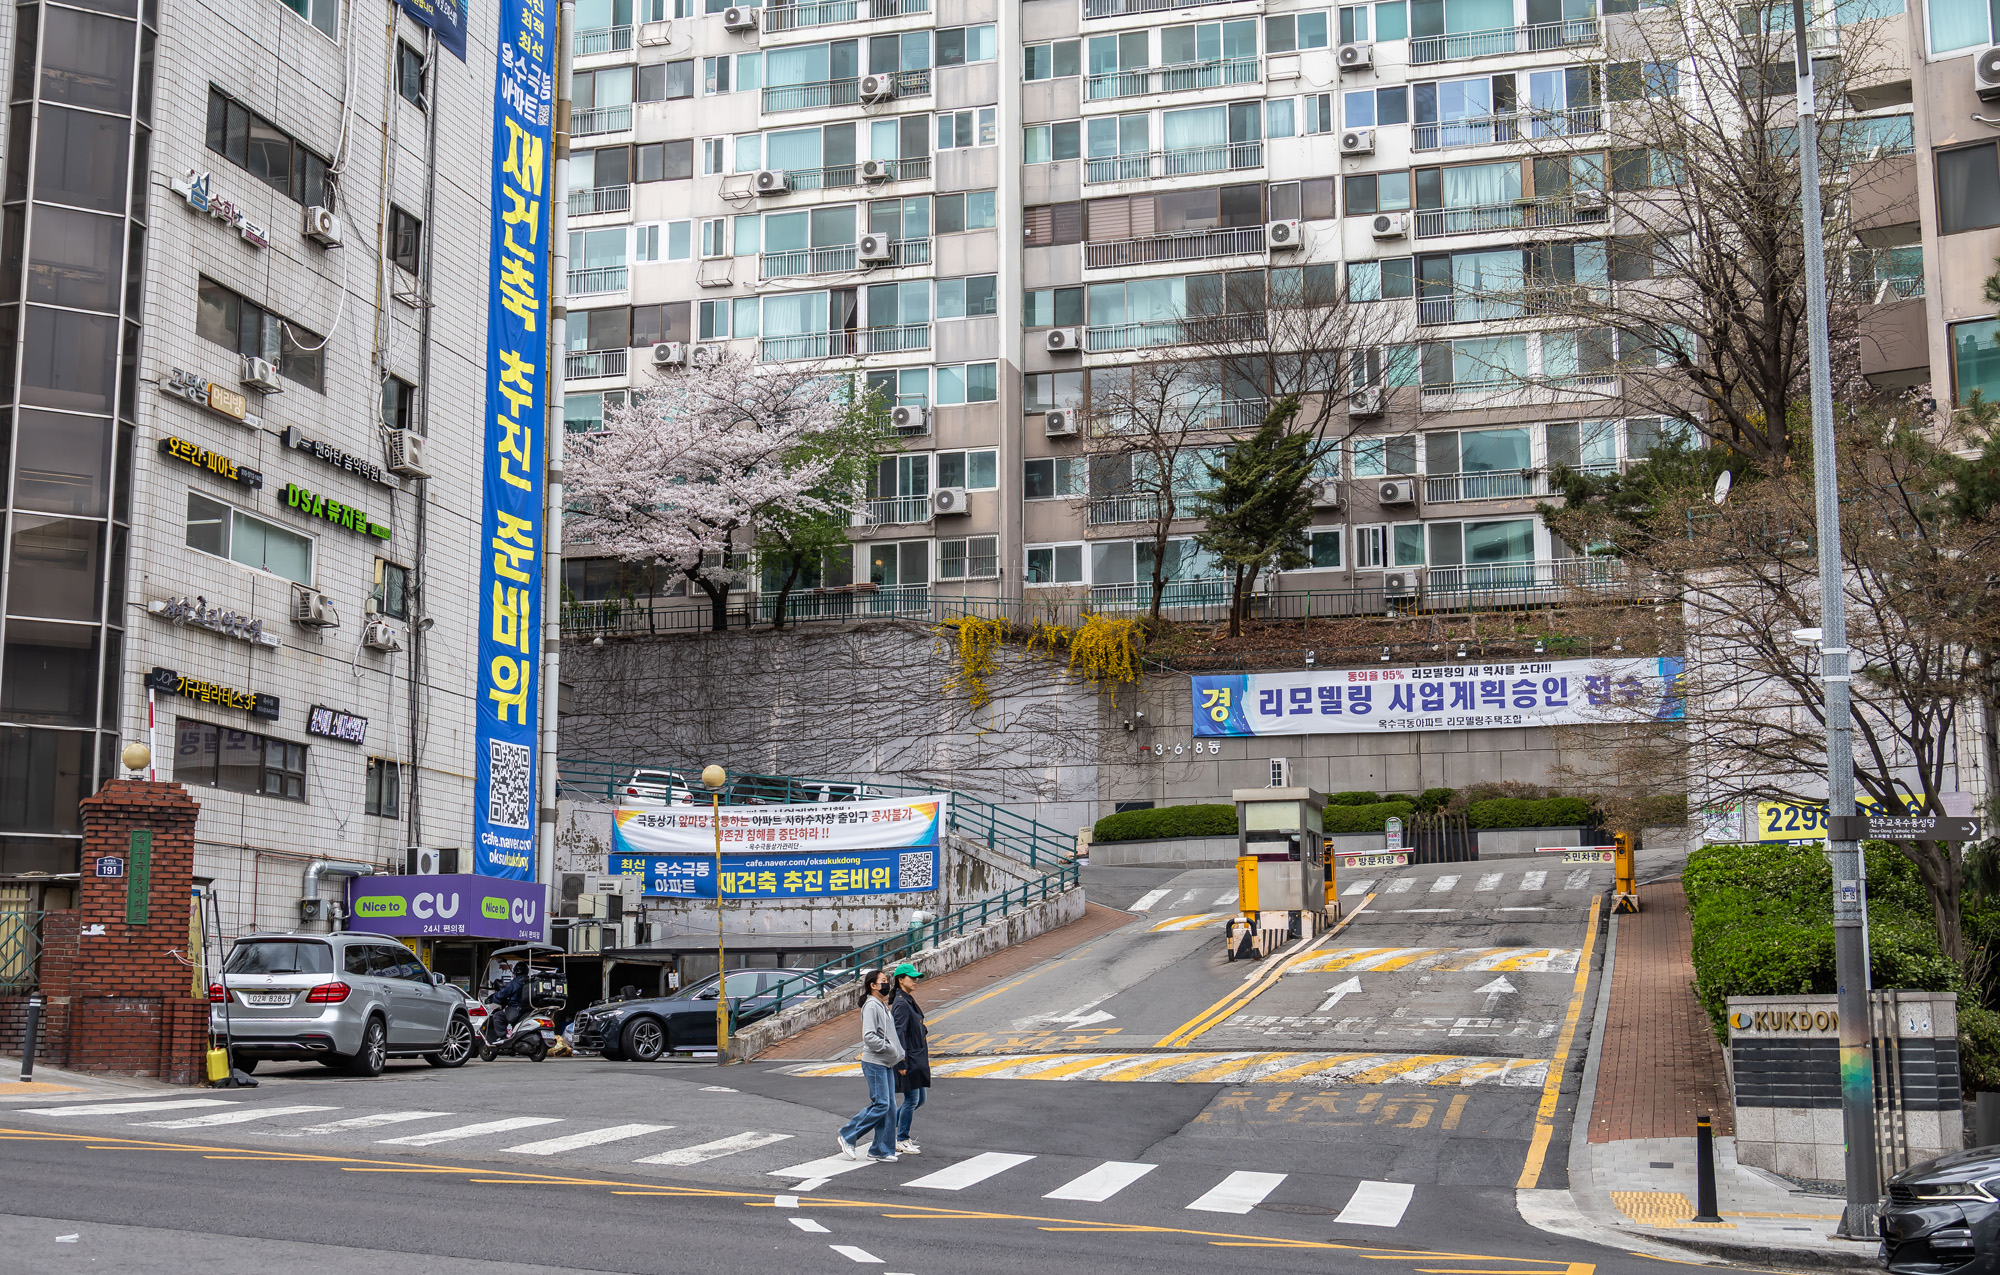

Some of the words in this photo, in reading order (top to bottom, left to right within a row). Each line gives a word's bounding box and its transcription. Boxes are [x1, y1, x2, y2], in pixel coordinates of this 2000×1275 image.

[518, 30, 544, 63] 최선
[502, 42, 551, 101] 옥수극동
[501, 72, 538, 124] 아파트
[499, 114, 543, 332] 재건축
[213, 387, 243, 415] 머리방
[497, 348, 535, 492] 추진
[315, 440, 342, 467] 맨하탄
[344, 453, 379, 483] 음악학원
[288, 483, 323, 518] DSA
[327, 499, 367, 534] 뮤지컬
[489, 508, 535, 726] 준비위
[1347, 670, 1379, 682] 동의율
[1382, 669, 1405, 681] 95%
[1411, 667, 1464, 680] 리모델링의
[1468, 666, 1479, 677] 새
[1483, 664, 1515, 676] 역사를
[1519, 663, 1552, 675] 쓰다!!!
[1201, 687, 1231, 722] 경
[1259, 685, 1372, 717] 리모델링
[1388, 676, 1569, 713] 사업계획승인
[1378, 716, 1443, 729] 옥수극동아파트
[1447, 713, 1522, 727] 리모델링주택조합
[637, 814, 676, 828] 극동상가
[678, 814, 708, 828] 앞마당
[752, 814, 782, 826] 아파트
[838, 810, 868, 824] 출입구
[871, 807, 913, 823] 공사불가
[1869, 818, 1936, 828] 천주교옥수동성당
[746, 827, 776, 842] 침해를
[778, 826, 819, 841] 중단하라
[821, 827, 830, 839] !!
[749, 842, 800, 851] 옥수극동상가관리단
[1563, 851, 1600, 862] 주민차량
[102, 866, 117, 875] 191
[621, 858, 645, 871] 최신
[654, 861, 710, 877] 옥수극동
[745, 856, 861, 868] cafe.naver.com/oksukukdong
[1358, 855, 1395, 867] 방문차량
[133, 835, 146, 921] 옥수극동아파트
[654, 878, 696, 893] 아파트
[720, 869, 778, 894] 재건축
[783, 869, 823, 893] 추진
[829, 866, 891, 892] 준비위
[362, 901, 387, 912] Nice
[388, 901, 400, 912] to
[412, 892, 460, 920] CU
[485, 902, 499, 914] Nice
[499, 904, 506, 914] to
[511, 897, 536, 925] CU
[423, 925, 440, 933] 24시
[442, 924, 465, 933] 편의점
[518, 929, 528, 938] 24시
[528, 930, 540, 939] 편의점
[268, 995, 287, 1003] 8286
[1754, 1011, 1840, 1032] KUKDON
[1192, 1091, 1470, 1130] 천천히
